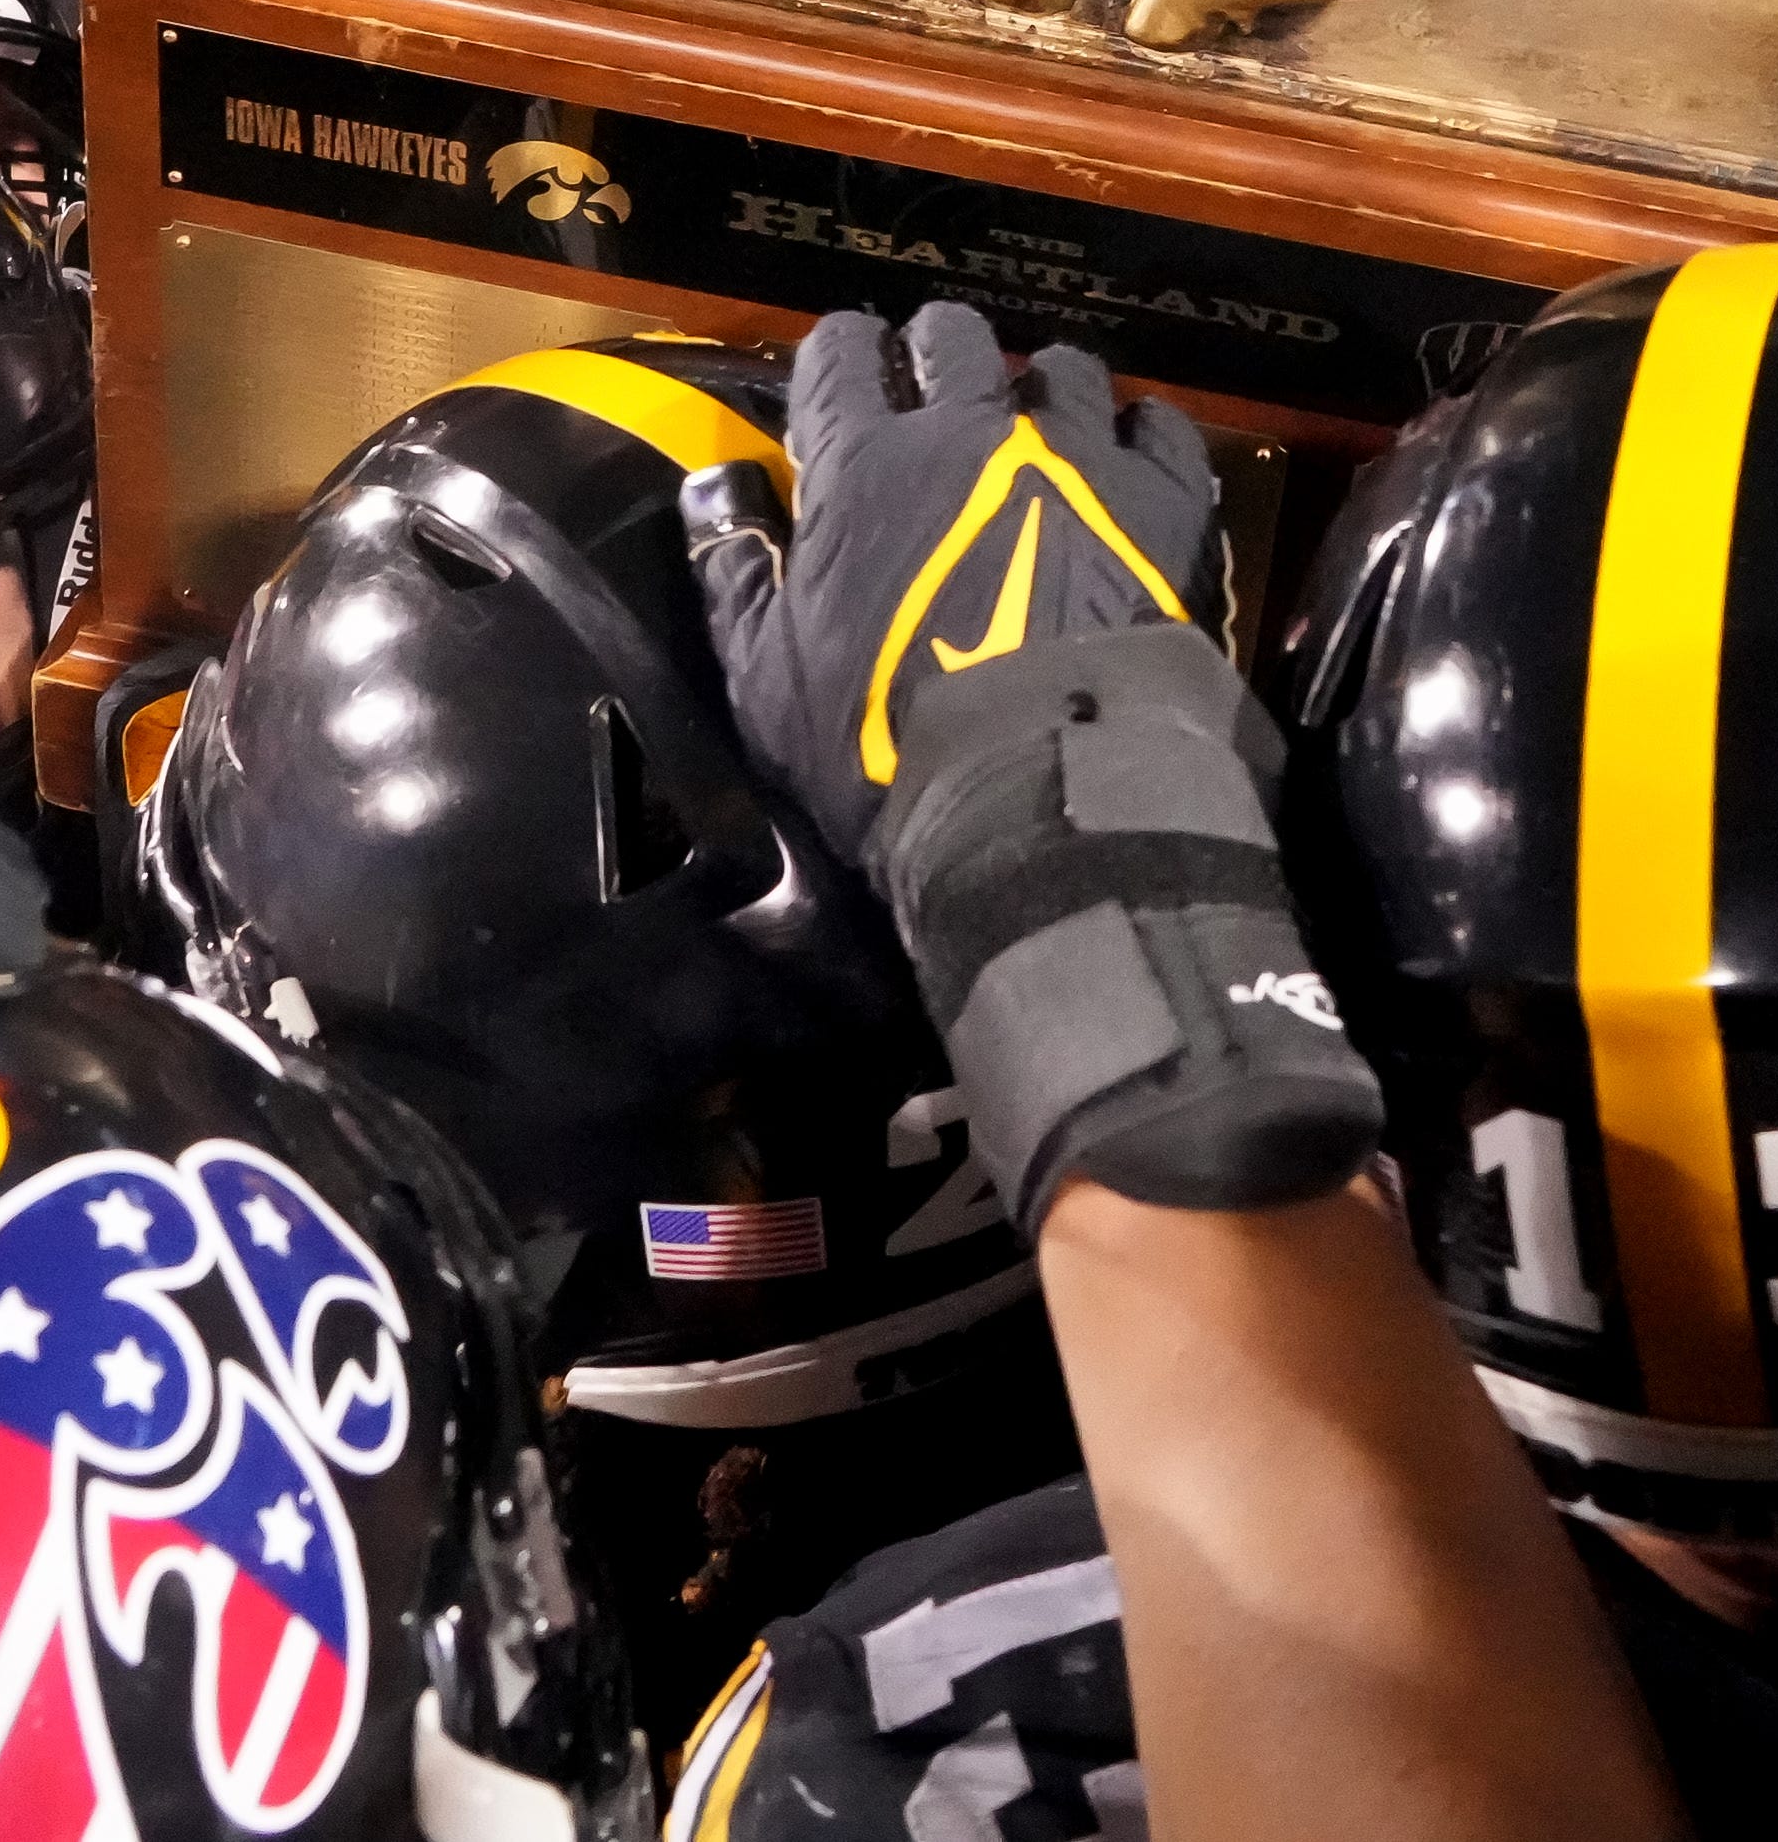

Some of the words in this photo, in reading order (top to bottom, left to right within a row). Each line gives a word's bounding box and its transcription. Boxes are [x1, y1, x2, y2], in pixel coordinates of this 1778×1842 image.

[225, 96, 304, 155] IOWA
[312, 114, 469, 187] HAWKEYES
[726, 190, 1341, 343] HEARTLAND
